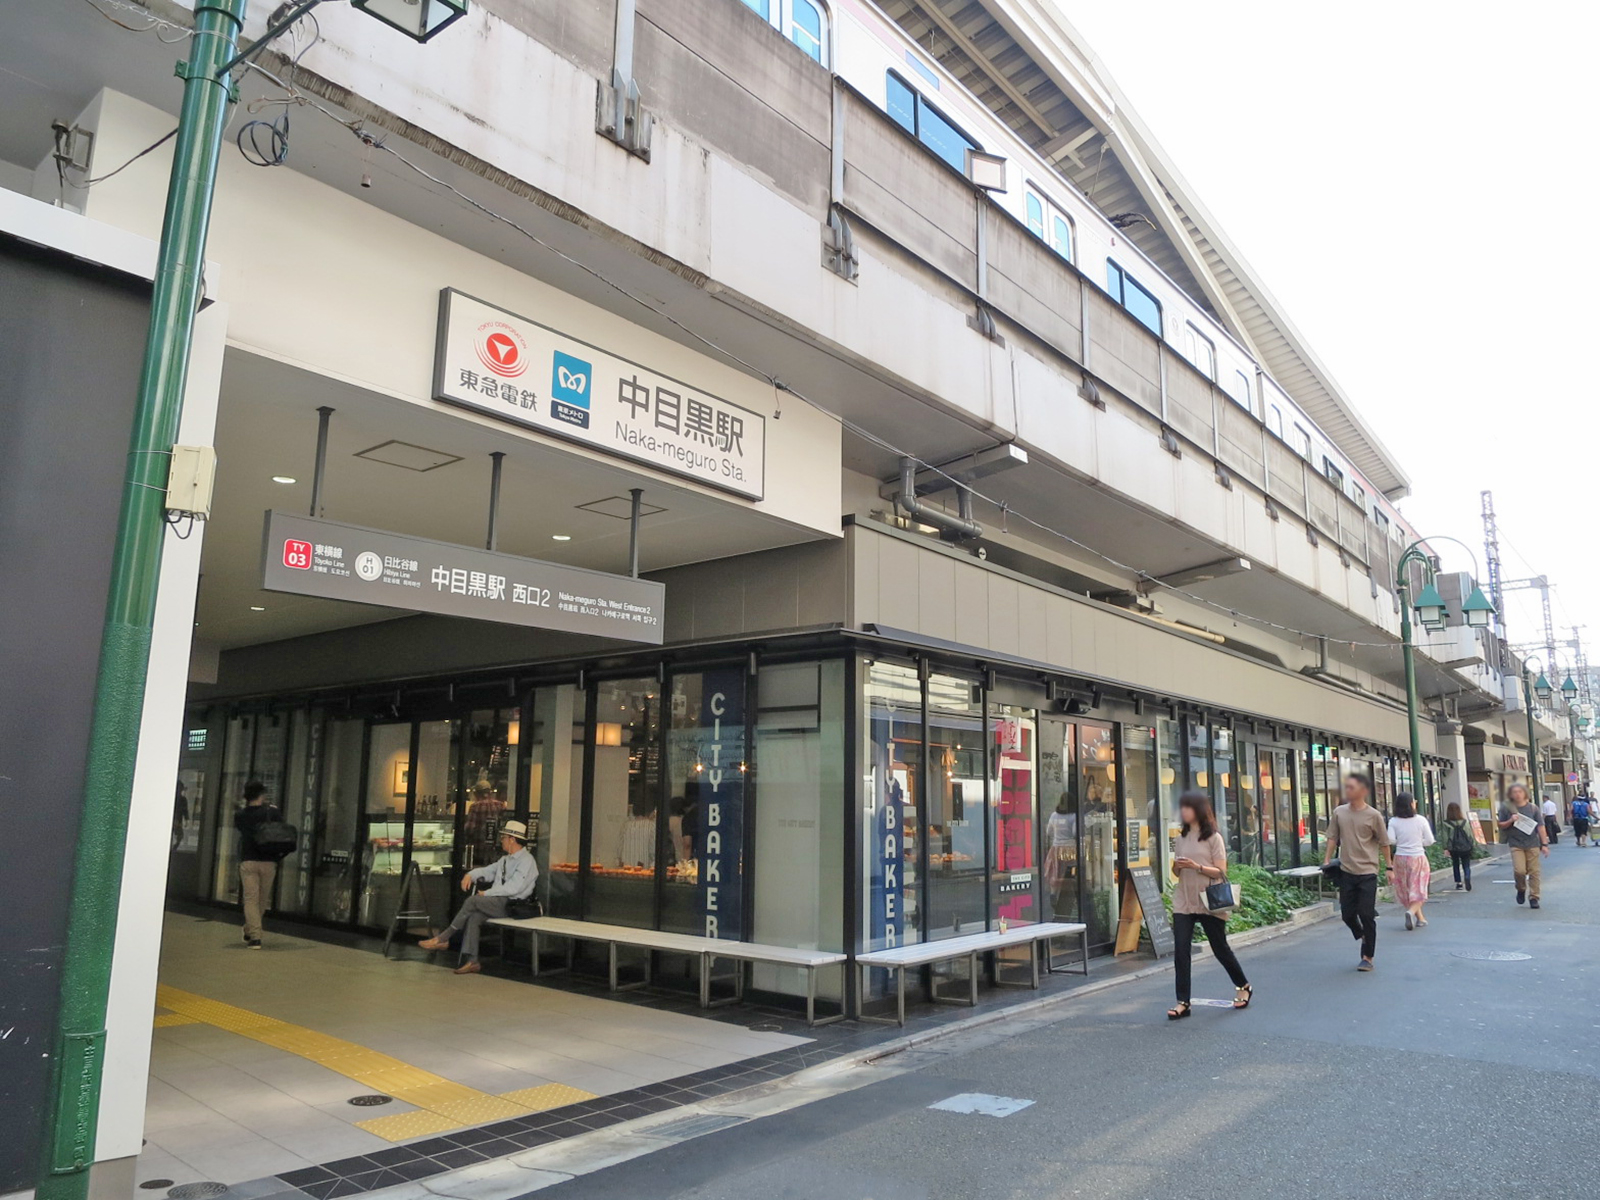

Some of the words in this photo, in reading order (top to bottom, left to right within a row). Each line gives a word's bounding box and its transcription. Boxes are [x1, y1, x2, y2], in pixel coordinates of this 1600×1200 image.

[477, 321, 494, 332] TOKYU
[495, 321, 528, 349] CORPORATION
[459, 367, 538, 412] 東急電鉄
[618, 374, 744, 458] 中目黒駅
[615, 420, 717, 473] Naka-meguro
[721, 458, 747, 483] Sta.
[292, 542, 306, 552] TY
[314, 544, 343, 559] 東横線
[288, 552, 306, 566] 03
[333, 560, 345, 568] Line
[366, 557, 373, 565] H
[384, 555, 419, 572] 日比谷線
[362, 565, 374, 574] 01
[399, 571, 411, 579] Line
[431, 564, 506, 601] 中目黒駅
[512, 583, 551, 608] 西口2
[558, 591, 597, 606] Naka-meguro
[597, 598, 608, 607] Sta.
[608, 600, 623, 610] West
[709, 692, 726, 792] CITY
[307, 724, 320, 790] CITY
[299, 798, 313, 906] BAKERY
[1000, 882, 1031, 892] BAKERY
